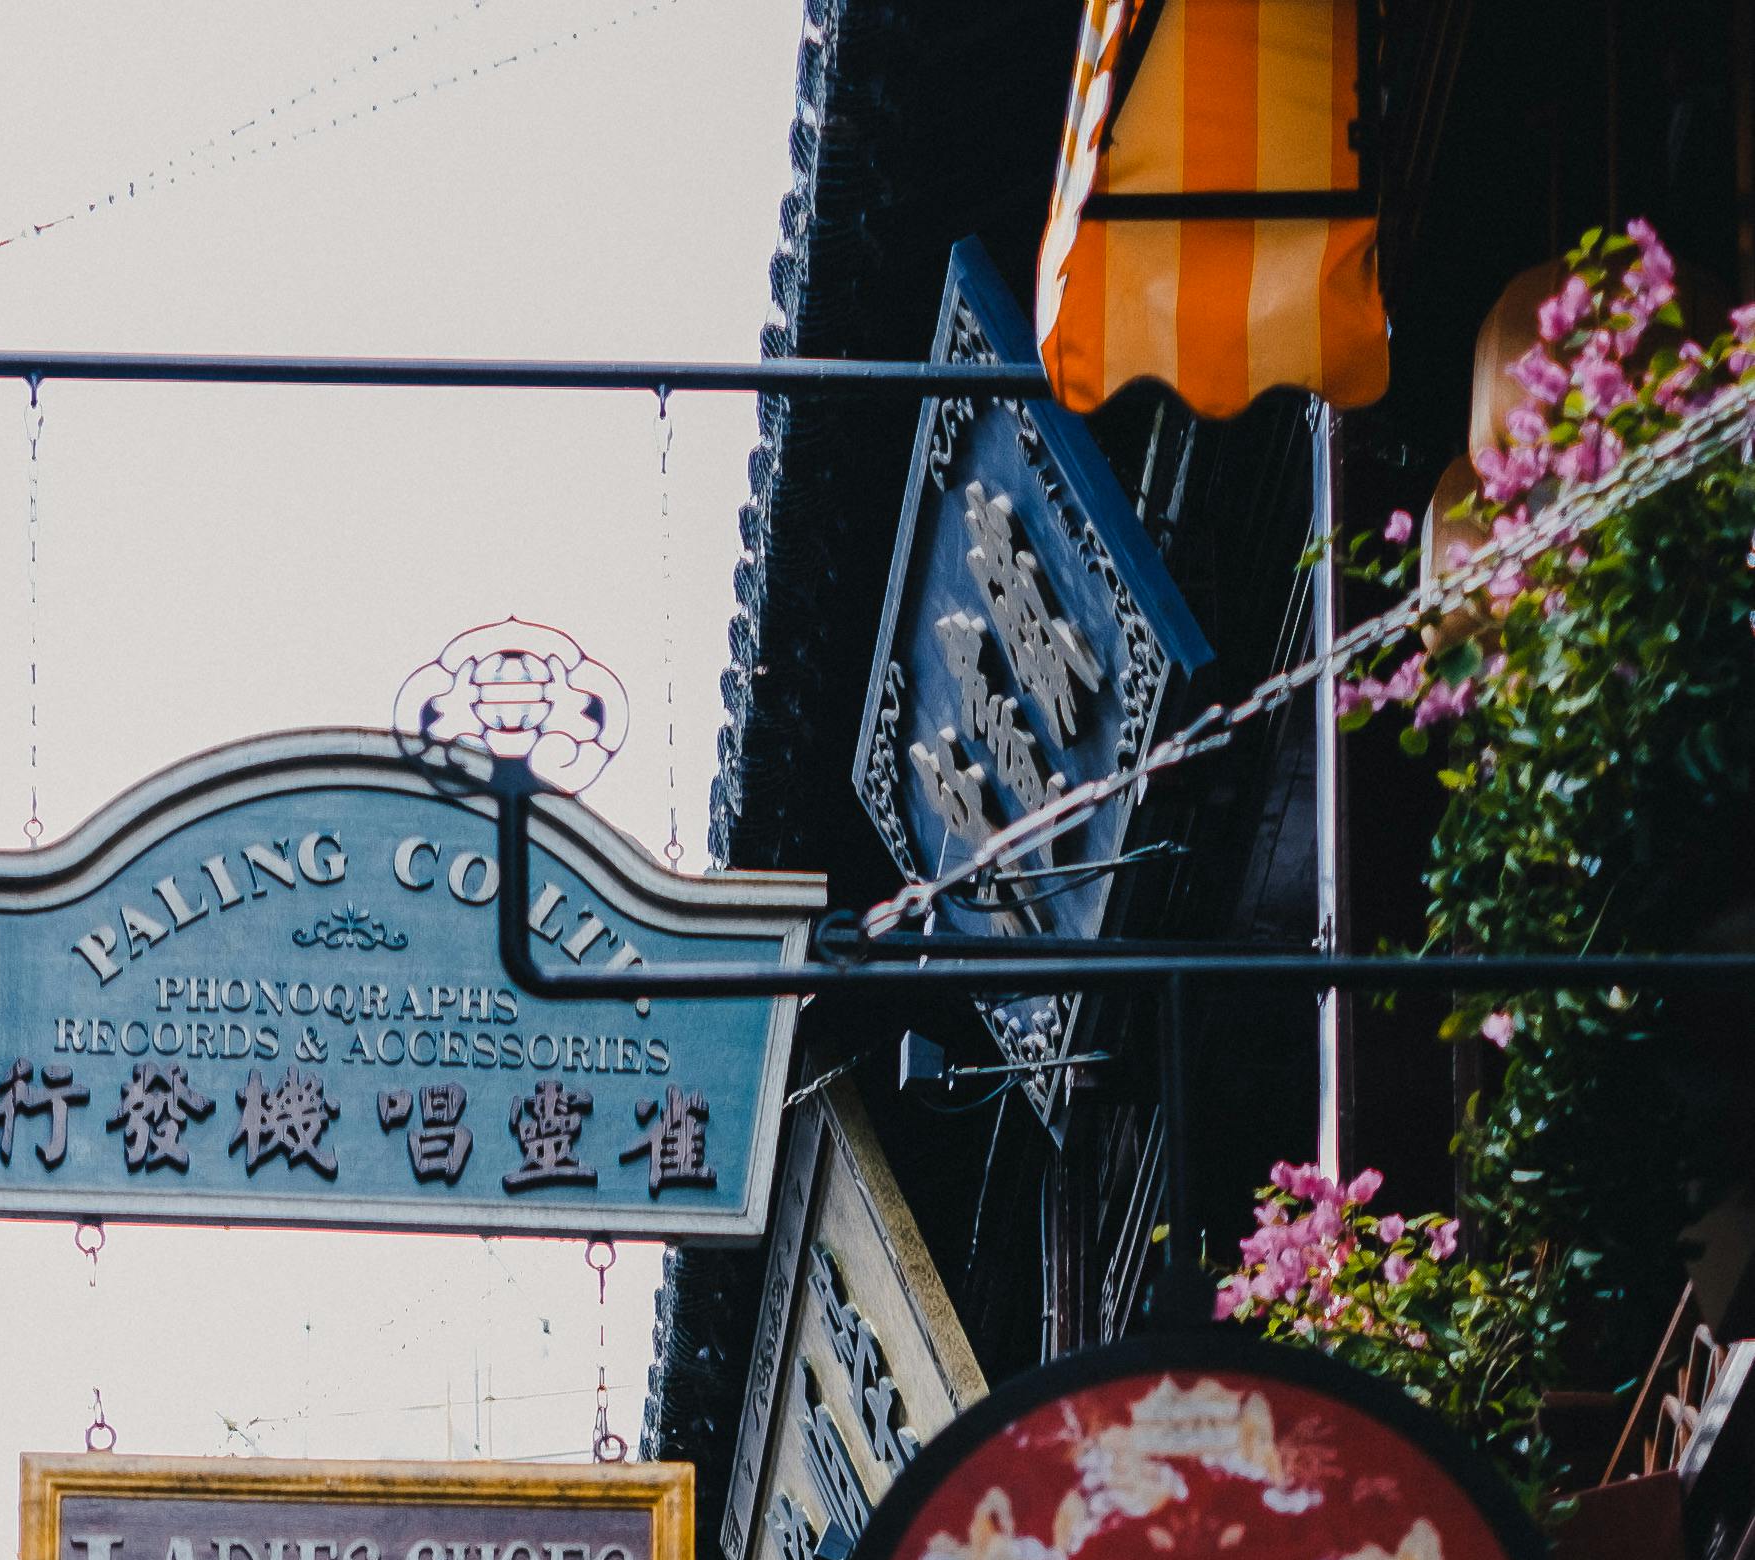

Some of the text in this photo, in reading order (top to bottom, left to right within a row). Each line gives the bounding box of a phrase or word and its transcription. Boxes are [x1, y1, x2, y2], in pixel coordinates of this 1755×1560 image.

[73, 830, 347, 986] PALING
[52, 1016, 673, 1076] RECORDS & ACCESSORIES
